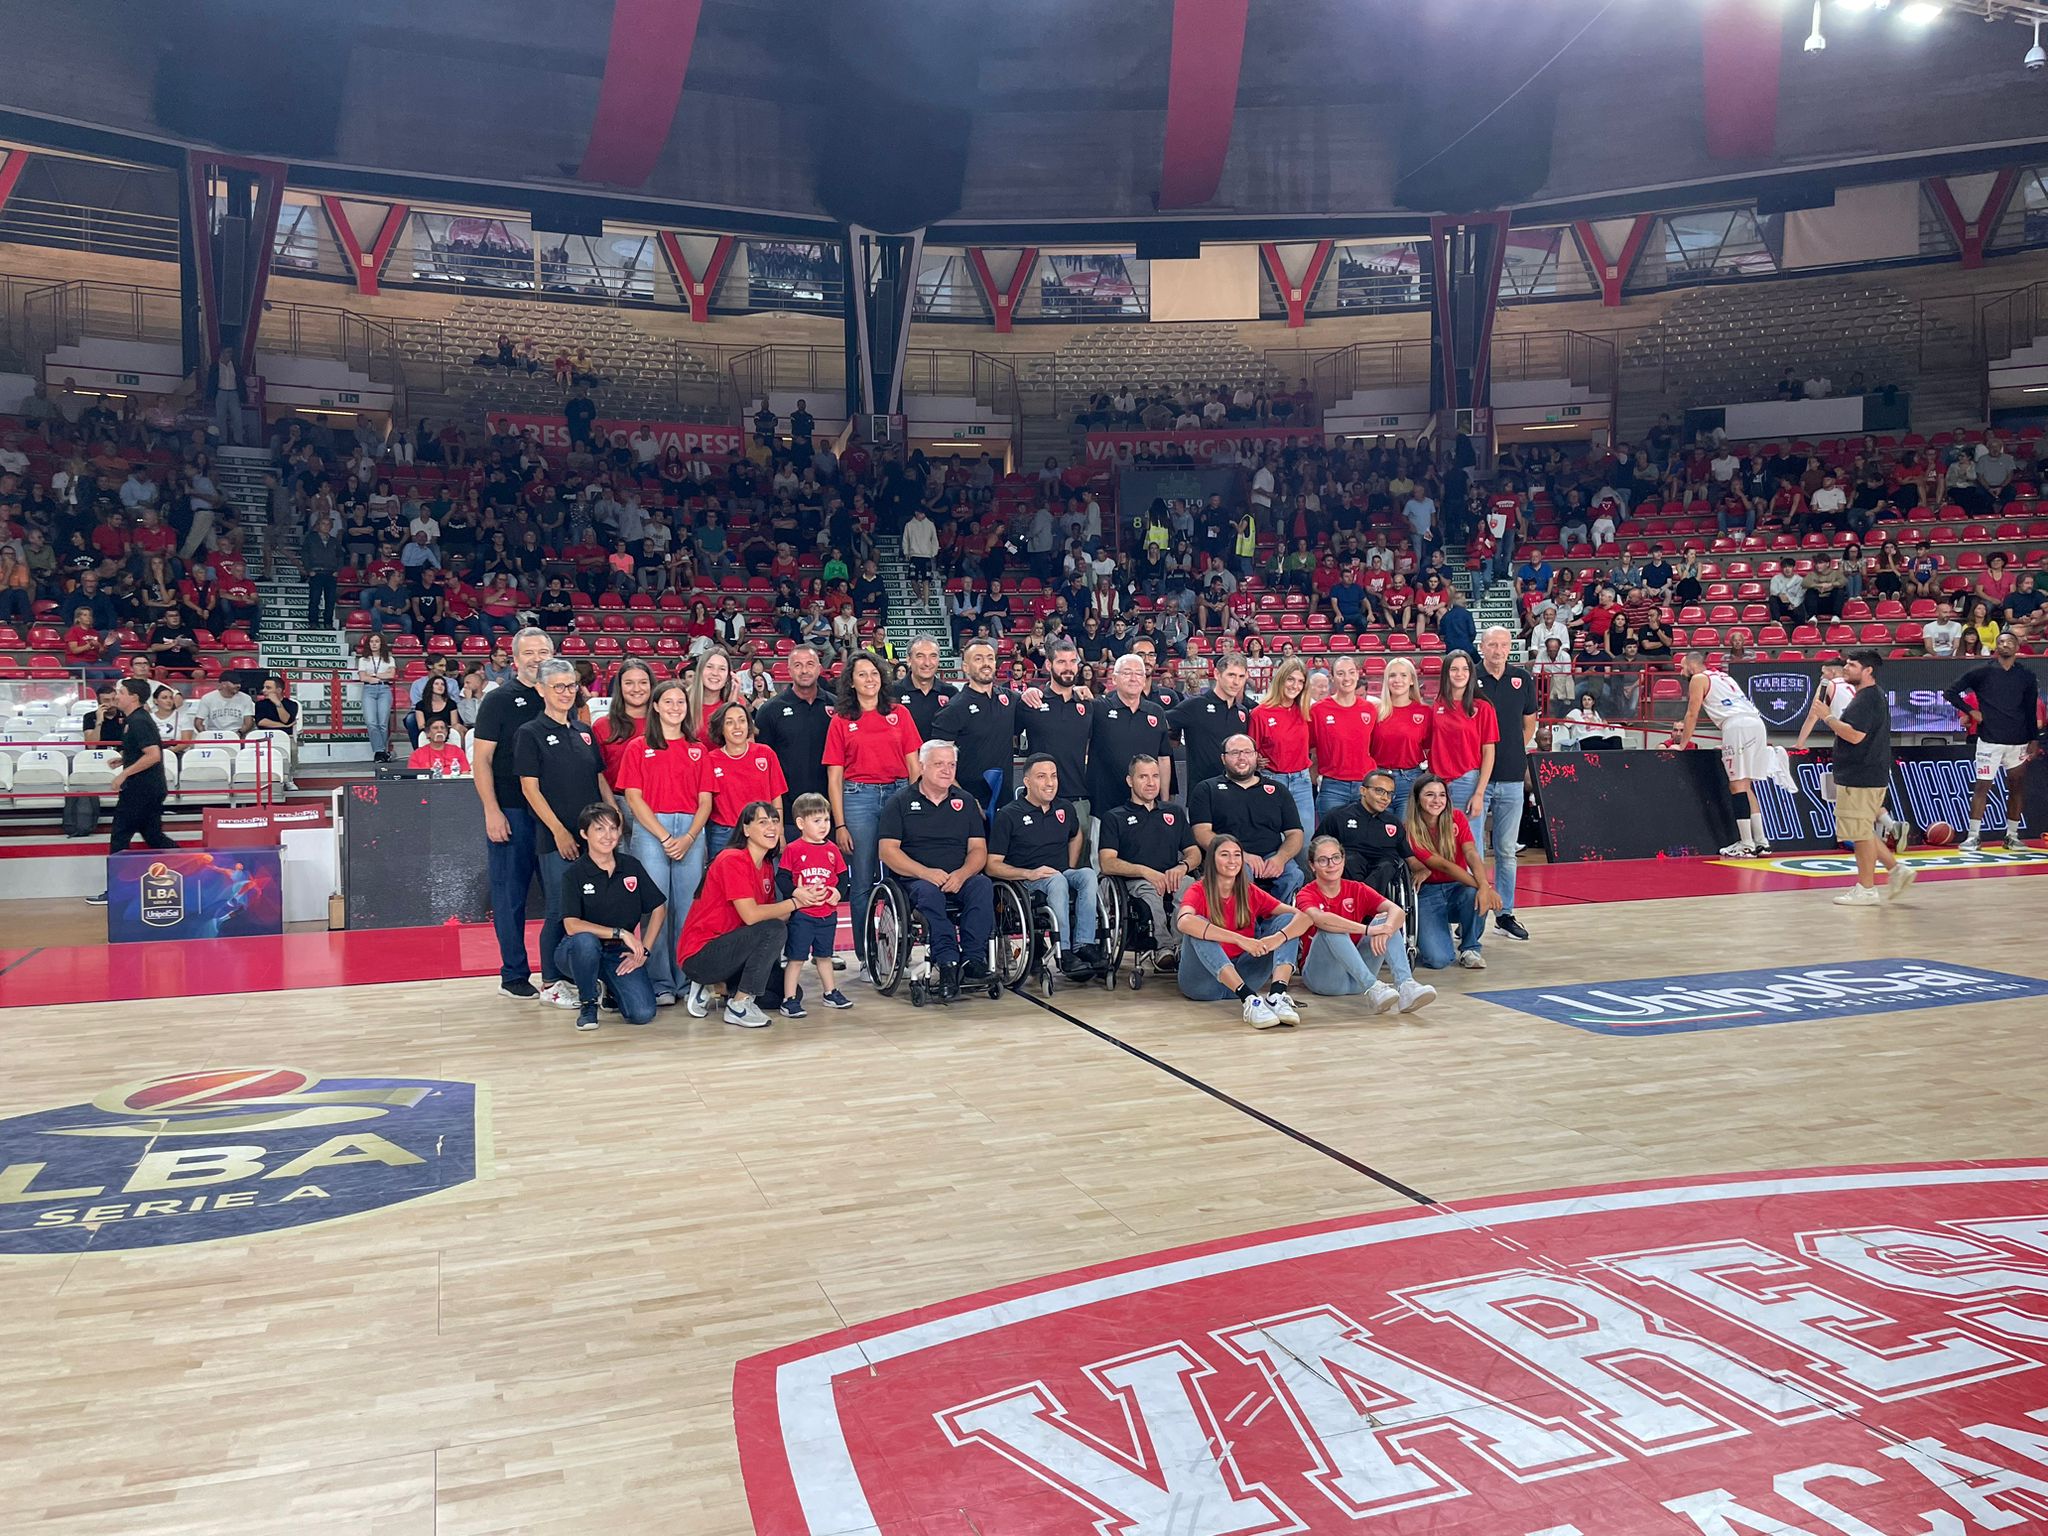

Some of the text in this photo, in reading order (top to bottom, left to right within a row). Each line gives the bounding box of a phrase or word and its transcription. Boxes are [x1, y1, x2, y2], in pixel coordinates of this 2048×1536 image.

[1753, 677, 1805, 688] VARESE
[211, 708, 242, 720] HILFIGER
[264, 731, 274, 739] 16
[37, 752, 48, 761] 14
[93, 752, 104, 760] 15
[1726, 758, 1733, 769] 7
[800, 867, 832, 878] VARESE
[147, 888, 179, 899] LBA
[1538, 965, 1996, 1016] UnipolSai
[1804, 982, 2030, 1010] ASSICURAZIONI
[0, 1132, 428, 1204] LBA
[34, 1184, 332, 1228] SERIE A
